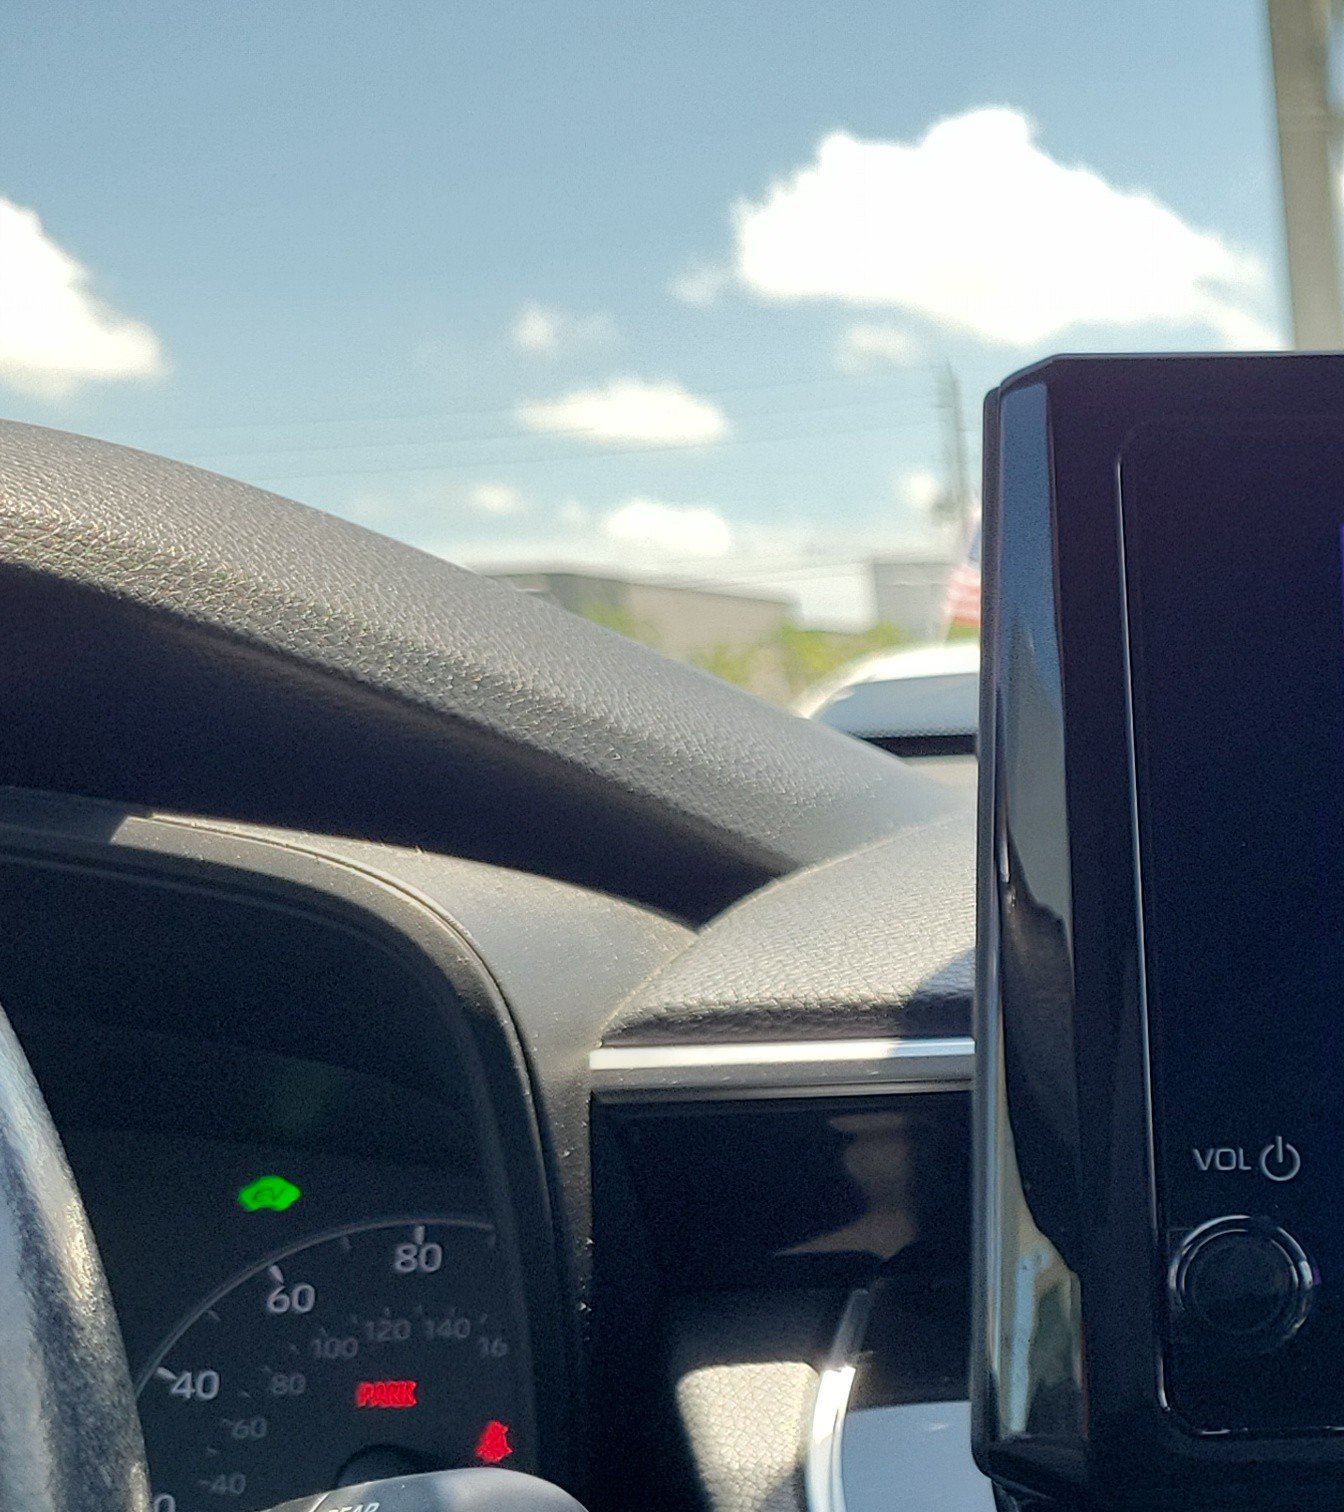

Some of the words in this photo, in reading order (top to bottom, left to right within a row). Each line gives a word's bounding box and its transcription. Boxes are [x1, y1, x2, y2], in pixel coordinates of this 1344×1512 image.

[1192, 1148, 1252, 1171] VOL
[394, 1242, 443, 1273] 80
[265, 1283, 316, 1314] 60
[364, 1317, 412, 1342] 120
[424, 1316, 472, 1340] 140
[312, 1335, 360, 1360] 100
[170, 1369, 220, 1401] 40
[270, 1372, 307, 1396] 80
[230, 1417, 268, 1440] 60
